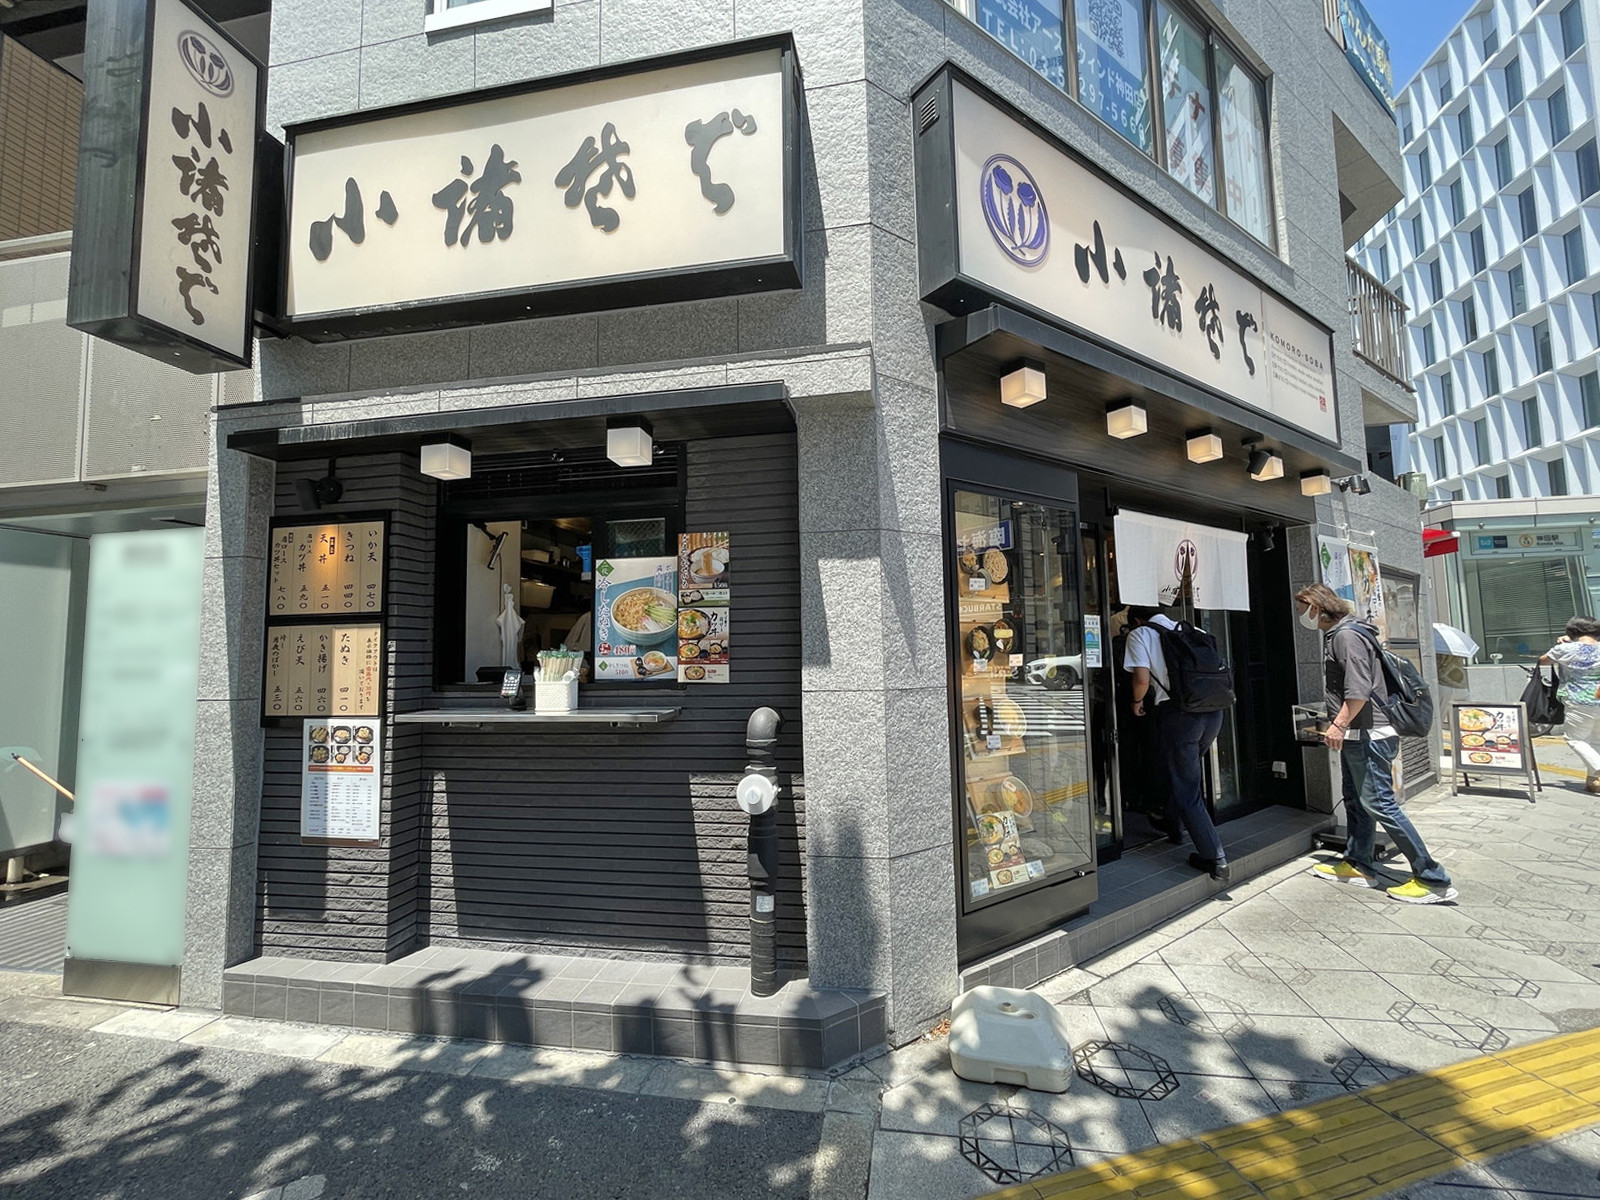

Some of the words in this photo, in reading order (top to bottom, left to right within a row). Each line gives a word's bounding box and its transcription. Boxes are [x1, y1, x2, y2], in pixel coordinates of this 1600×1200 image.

[344, 531, 355, 563] きつね
[367, 529, 377, 562] いか天
[295, 633, 306, 666] えび天
[317, 634, 328, 674] かき揚げ
[340, 633, 351, 665] たぬき
